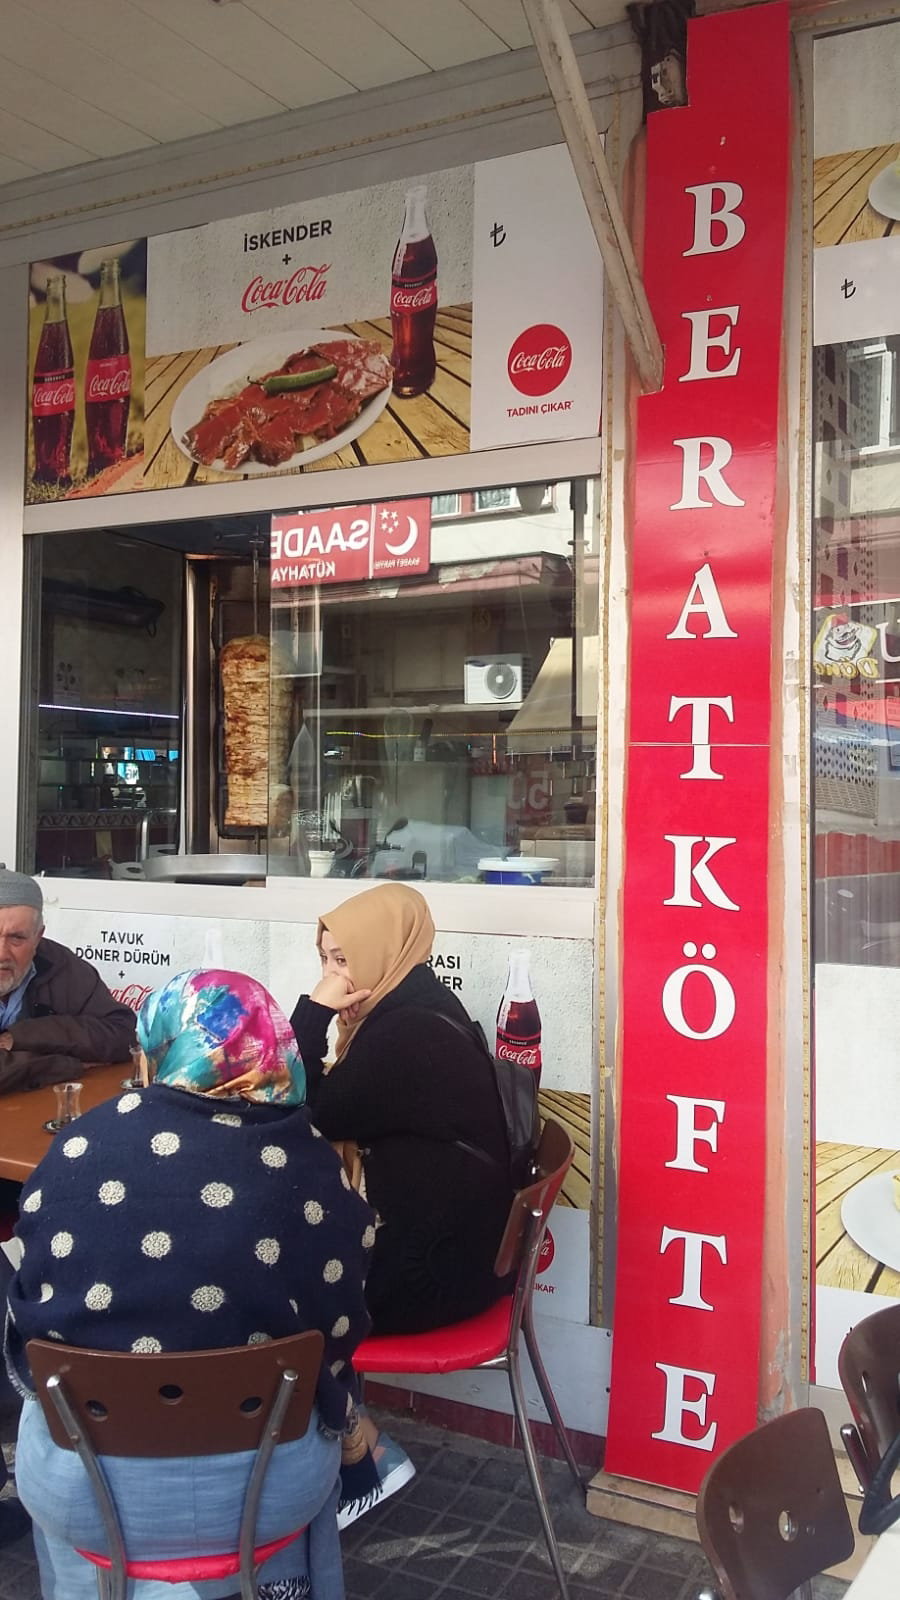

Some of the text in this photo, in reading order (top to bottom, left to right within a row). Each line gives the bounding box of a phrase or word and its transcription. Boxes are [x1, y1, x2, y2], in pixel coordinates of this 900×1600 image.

[243, 219, 332, 252] İSKENDER
[241, 263, 332, 313] Coca-Cola
[393, 286, 434, 307] Coca-Cola
[510, 345, 569, 374] Coca-Cola
[89, 370, 130, 397] Coca-Cola
[33, 383, 74, 407] Coca-Cola
[506, 400, 572, 418] TADINI ÇIKAR
[101, 931, 144, 945] TAVUK
[76, 945, 171, 966] DÖNER DÜRÜM
[498, 1045, 538, 1065] Coca-Cola
[533, 1283, 555, 1294] IKAR
